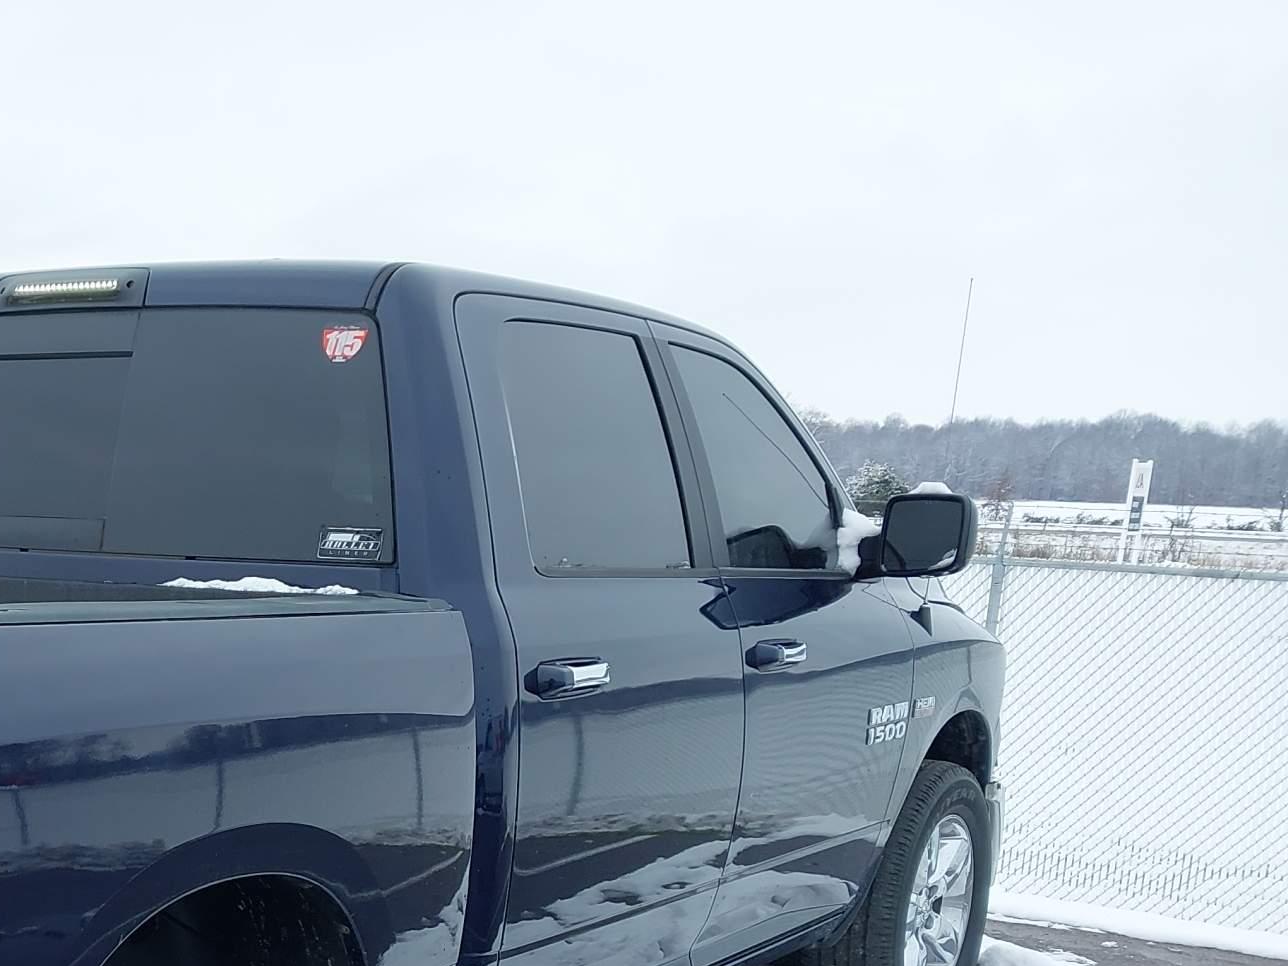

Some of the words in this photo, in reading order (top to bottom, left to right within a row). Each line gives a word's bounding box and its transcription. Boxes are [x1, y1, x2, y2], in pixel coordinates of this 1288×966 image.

[326, 330, 365, 356] 115
[868, 701, 909, 726] RAM
[866, 721, 907, 746] 1500
